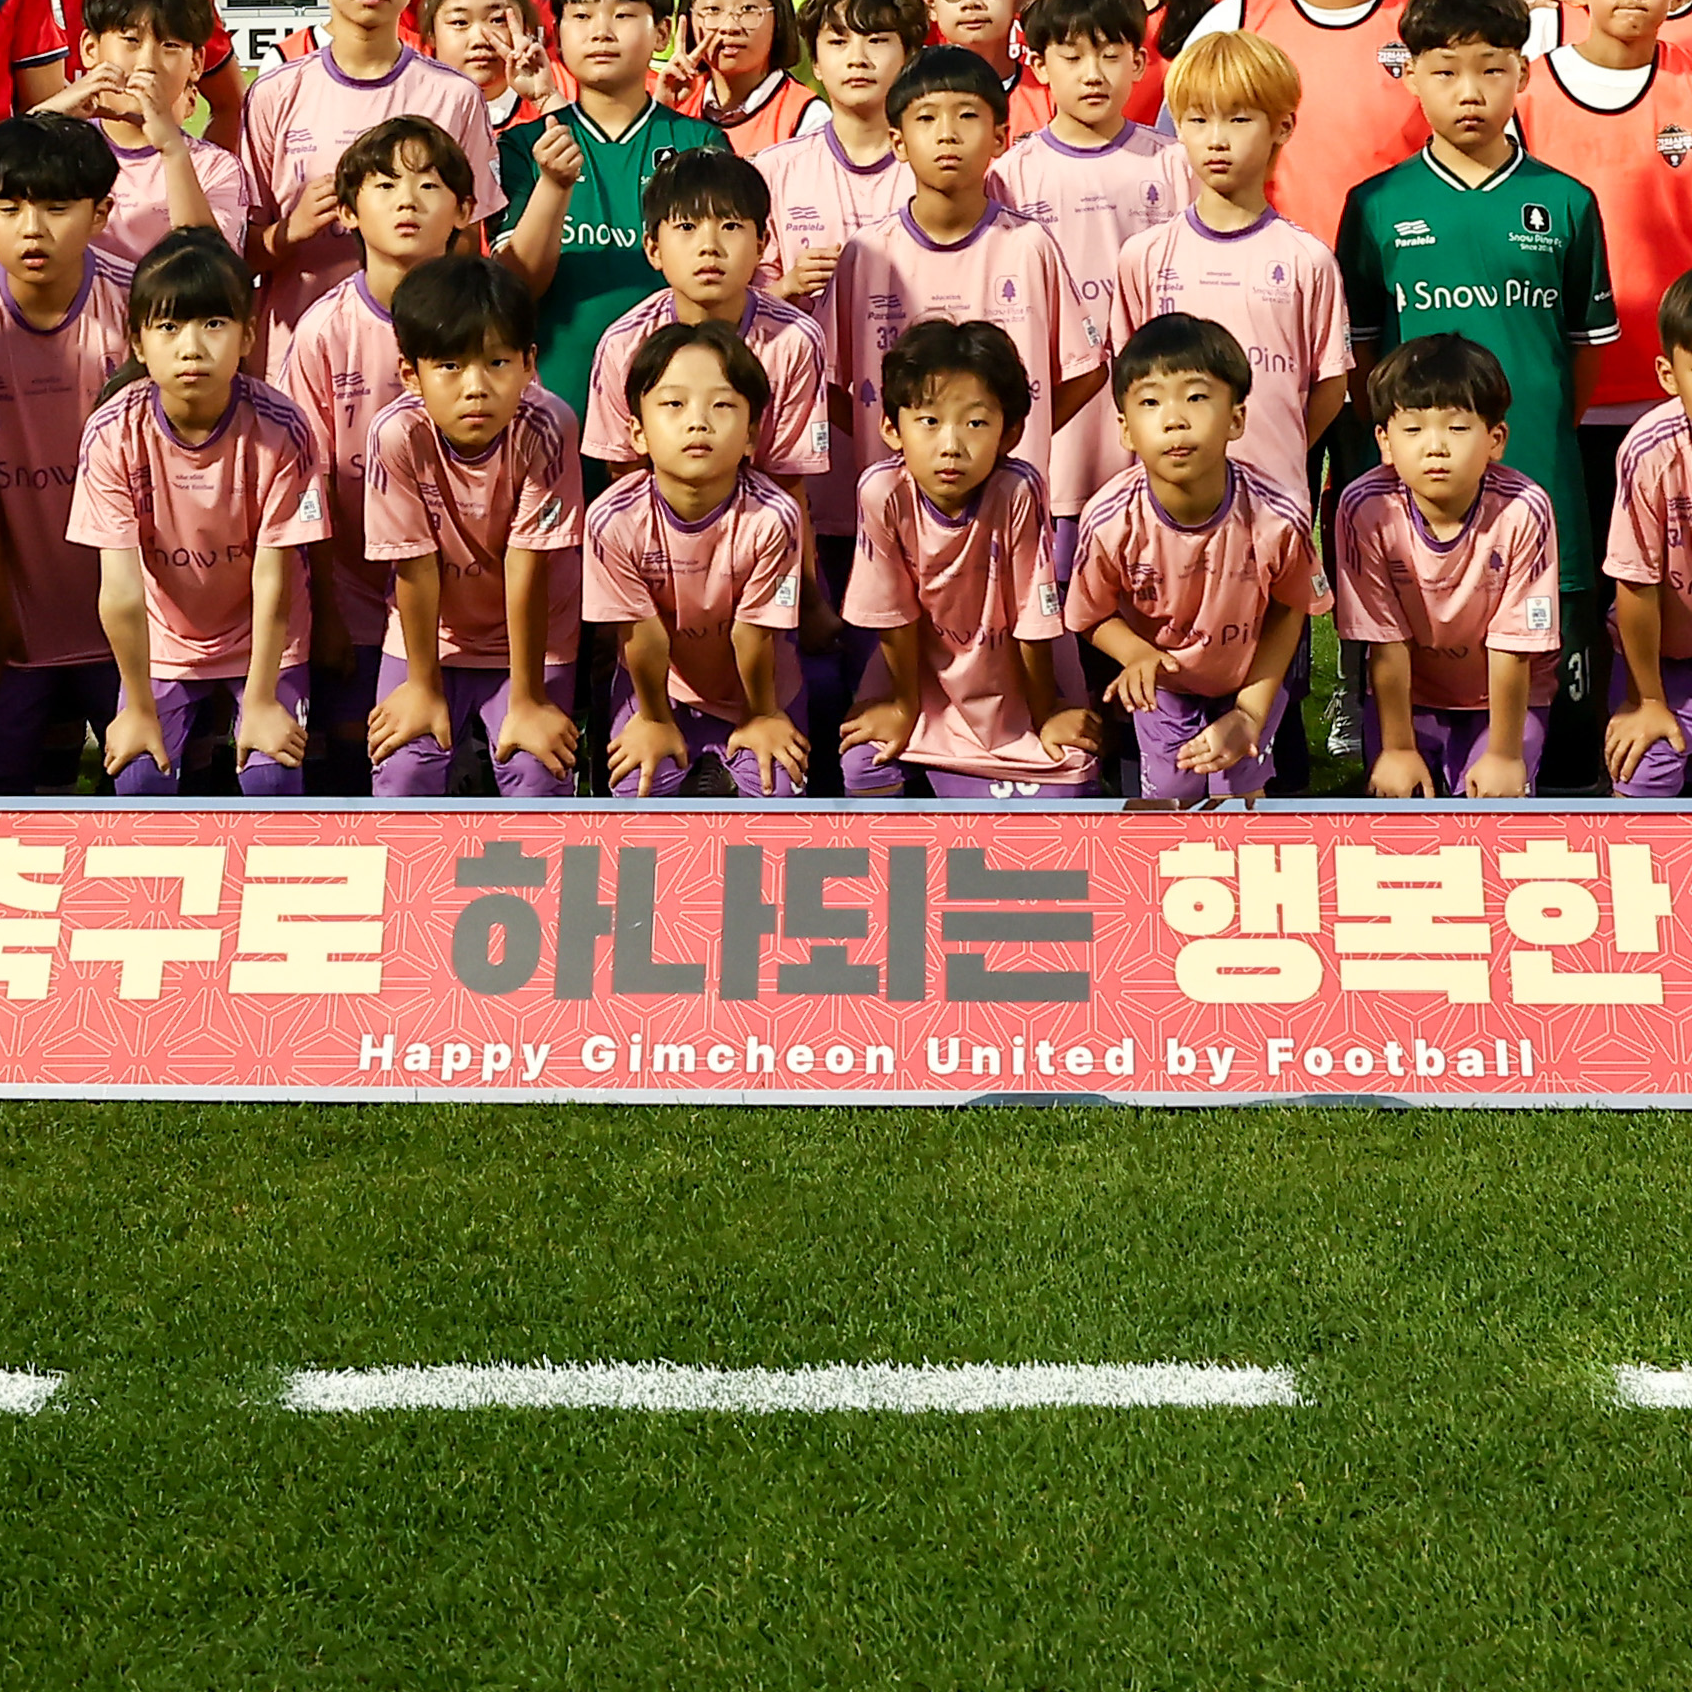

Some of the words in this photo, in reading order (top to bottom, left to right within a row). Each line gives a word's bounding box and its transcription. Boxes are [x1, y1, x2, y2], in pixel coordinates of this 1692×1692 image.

[562, 218, 639, 248] Snow
[785, 222, 826, 233] Paralela
[1508, 232, 1533, 243] Snow
[1395, 235, 1436, 248] Paralela
[1414, 279, 1499, 310] Snow
[154, 544, 217, 569] now
[451, 841, 1095, 1003] 하나되는
[1158, 839, 1673, 1005] 행복한
[358, 1034, 551, 1081] Happy
[581, 1034, 896, 1074] Gimcheon
[926, 1036, 1135, 1077] United
[1167, 1037, 1237, 1084] by
[1266, 1038, 1535, 1078] Football
